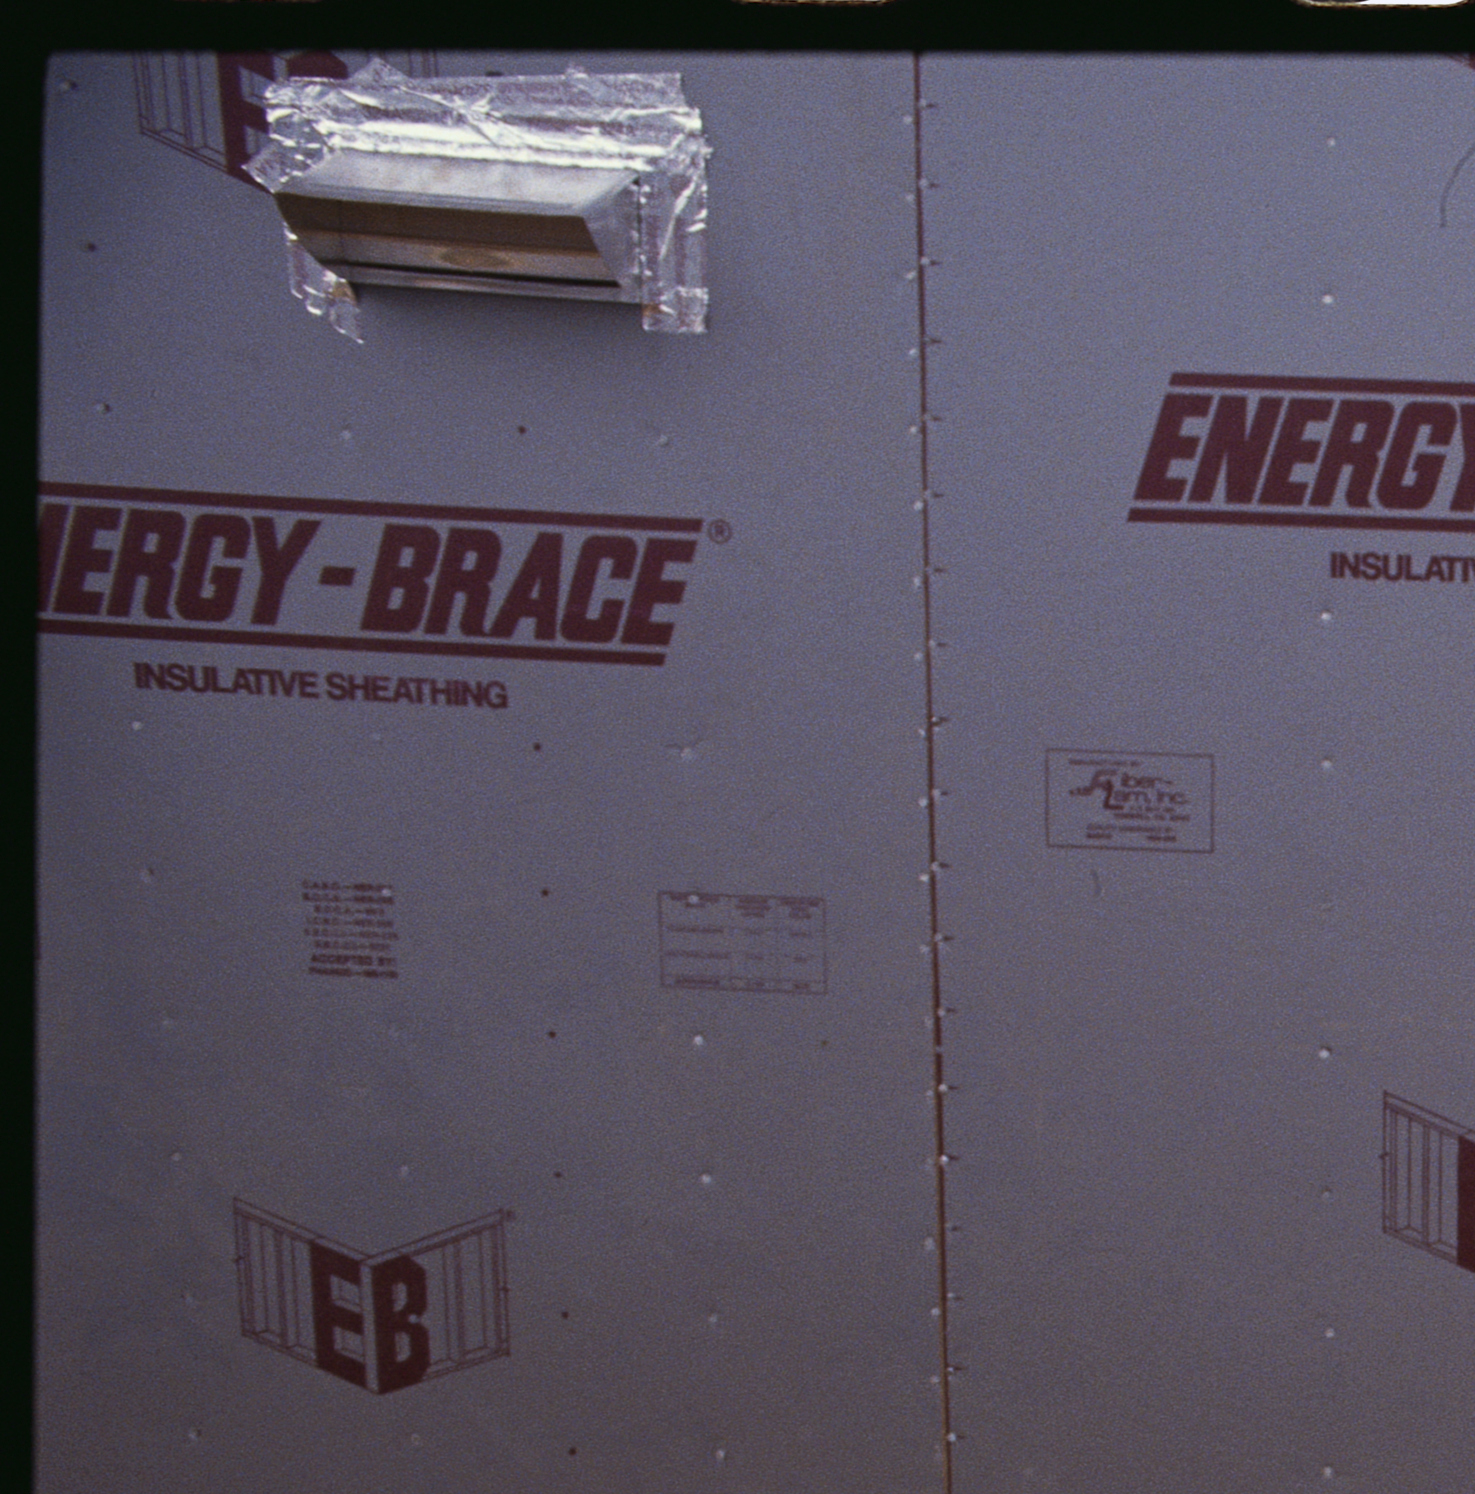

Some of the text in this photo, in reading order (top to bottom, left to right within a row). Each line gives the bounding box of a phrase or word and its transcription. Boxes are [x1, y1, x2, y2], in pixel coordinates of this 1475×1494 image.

[133, 662, 508, 709] INSULATIVE SHEATHING
[311, 1240, 430, 1396] EB
